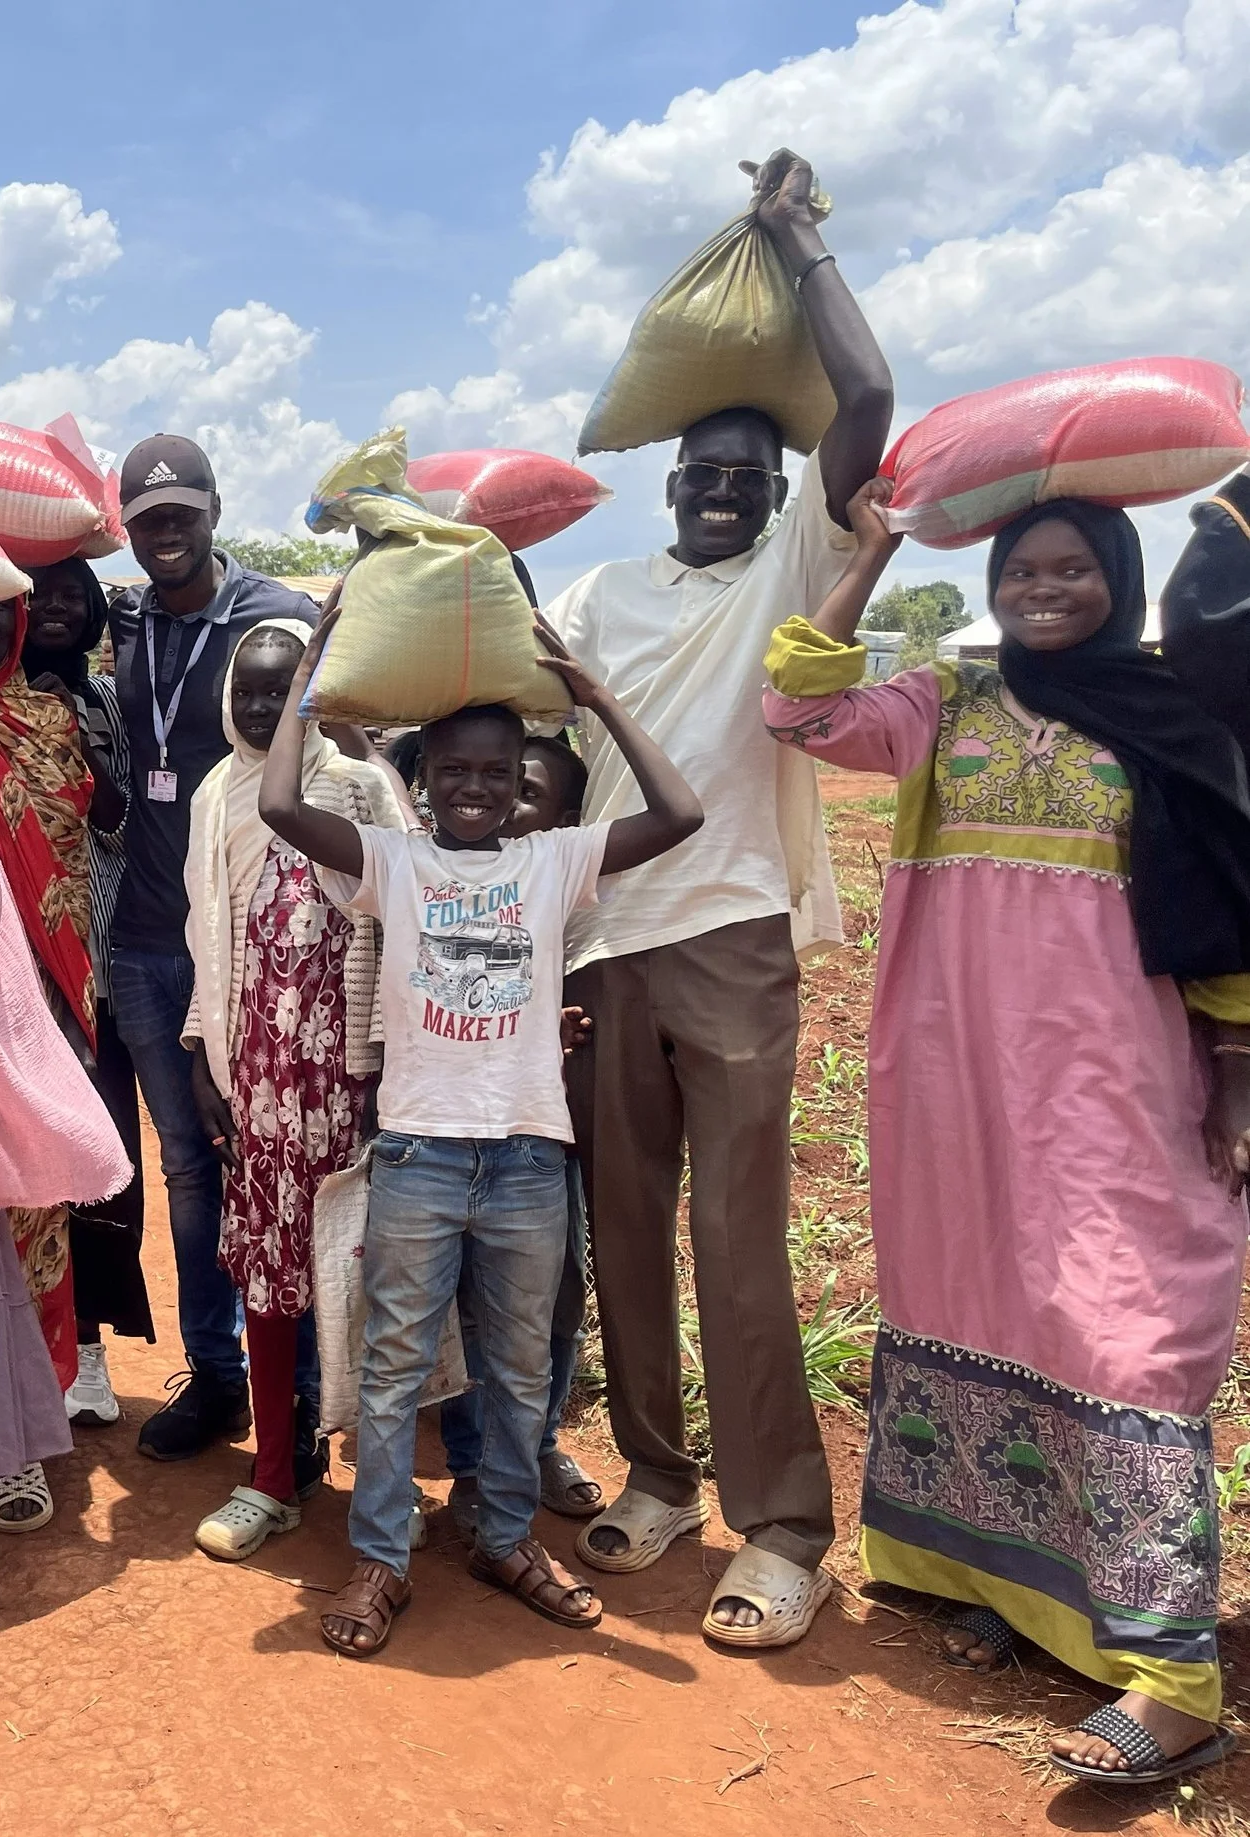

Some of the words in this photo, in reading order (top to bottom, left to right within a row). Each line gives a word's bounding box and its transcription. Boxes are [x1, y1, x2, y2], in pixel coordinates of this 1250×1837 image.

[144, 473, 178, 486] adidas
[426, 881, 518, 928] FOLLOW
[498, 903, 523, 926] ME
[422, 997, 493, 1042] MAKE
[496, 1009, 521, 1040] IT
